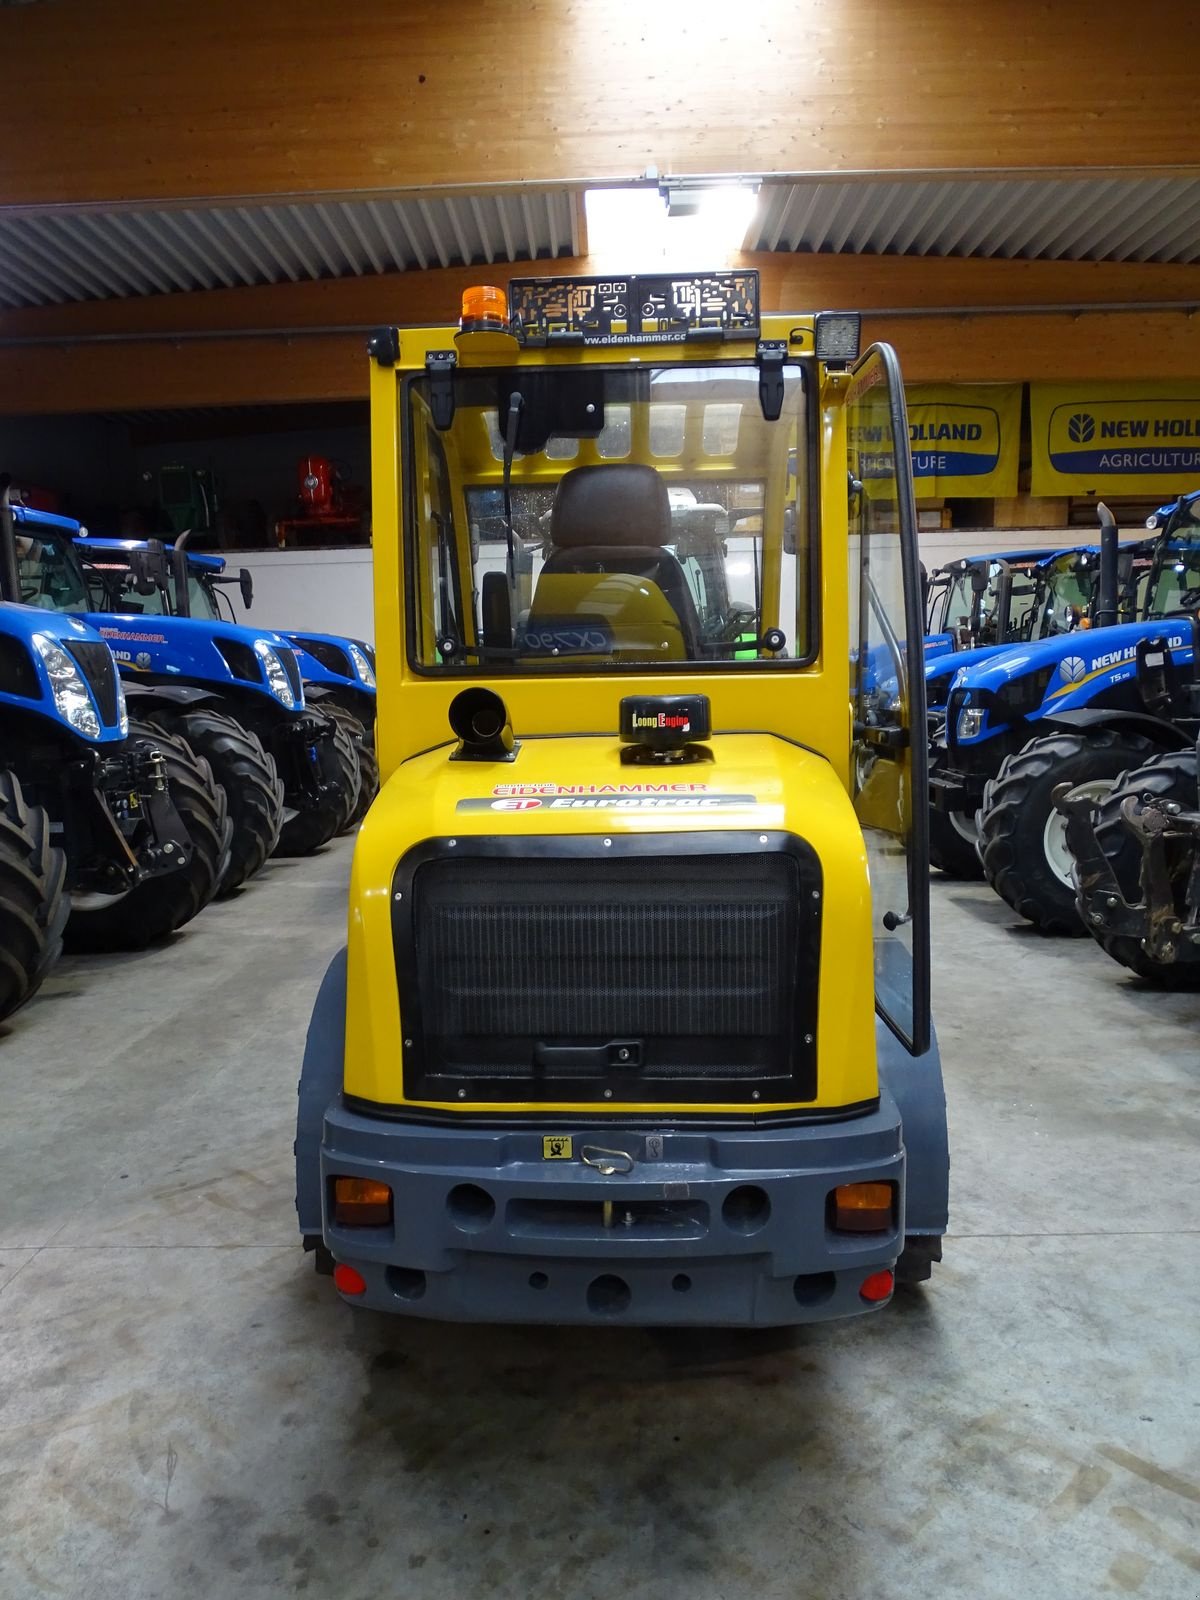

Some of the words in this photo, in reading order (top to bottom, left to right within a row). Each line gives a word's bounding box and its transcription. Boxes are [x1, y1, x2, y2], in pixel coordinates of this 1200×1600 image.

[1101, 420, 1149, 438] NEW
[1154, 419, 1200, 438] HOLL
[1099, 452, 1200, 468] AGRICULTUR
[1091, 650, 1122, 671] NEW
[492, 784, 708, 797] EIDENHAMMER
[548, 798, 721, 809] Eurotrac
